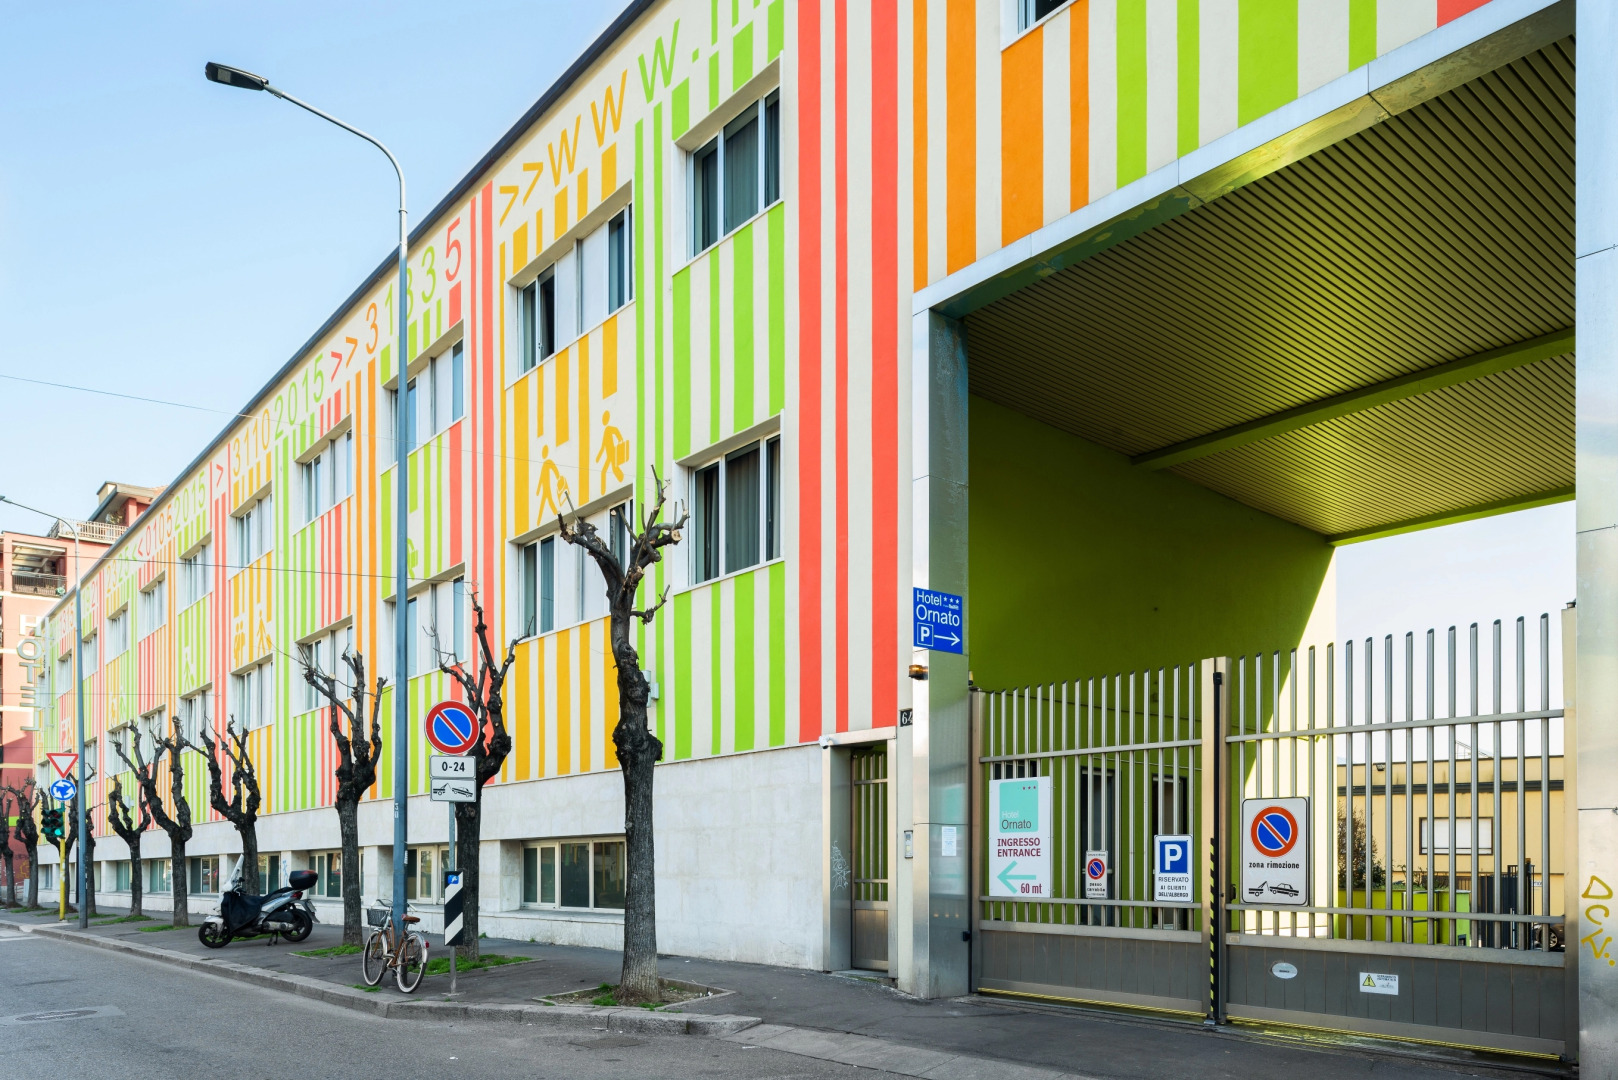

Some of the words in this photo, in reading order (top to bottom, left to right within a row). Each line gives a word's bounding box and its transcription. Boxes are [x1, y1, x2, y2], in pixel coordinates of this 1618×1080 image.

[916, 590, 942, 606] Hotel
[916, 604, 960, 627] Ornato
[441, 761, 465, 772] 0-24
[1001, 810, 1019, 819] Hotel
[1001, 819, 1032, 830] Ornato
[997, 837, 1041, 847] INGRESSO
[997, 848, 1041, 857] ENTRANCE
[1164, 844, 1182, 871] P
[1266, 860, 1300, 869] rimozione
[1020, 883, 1030, 894] 60
[1032, 883, 1042, 894] mt
